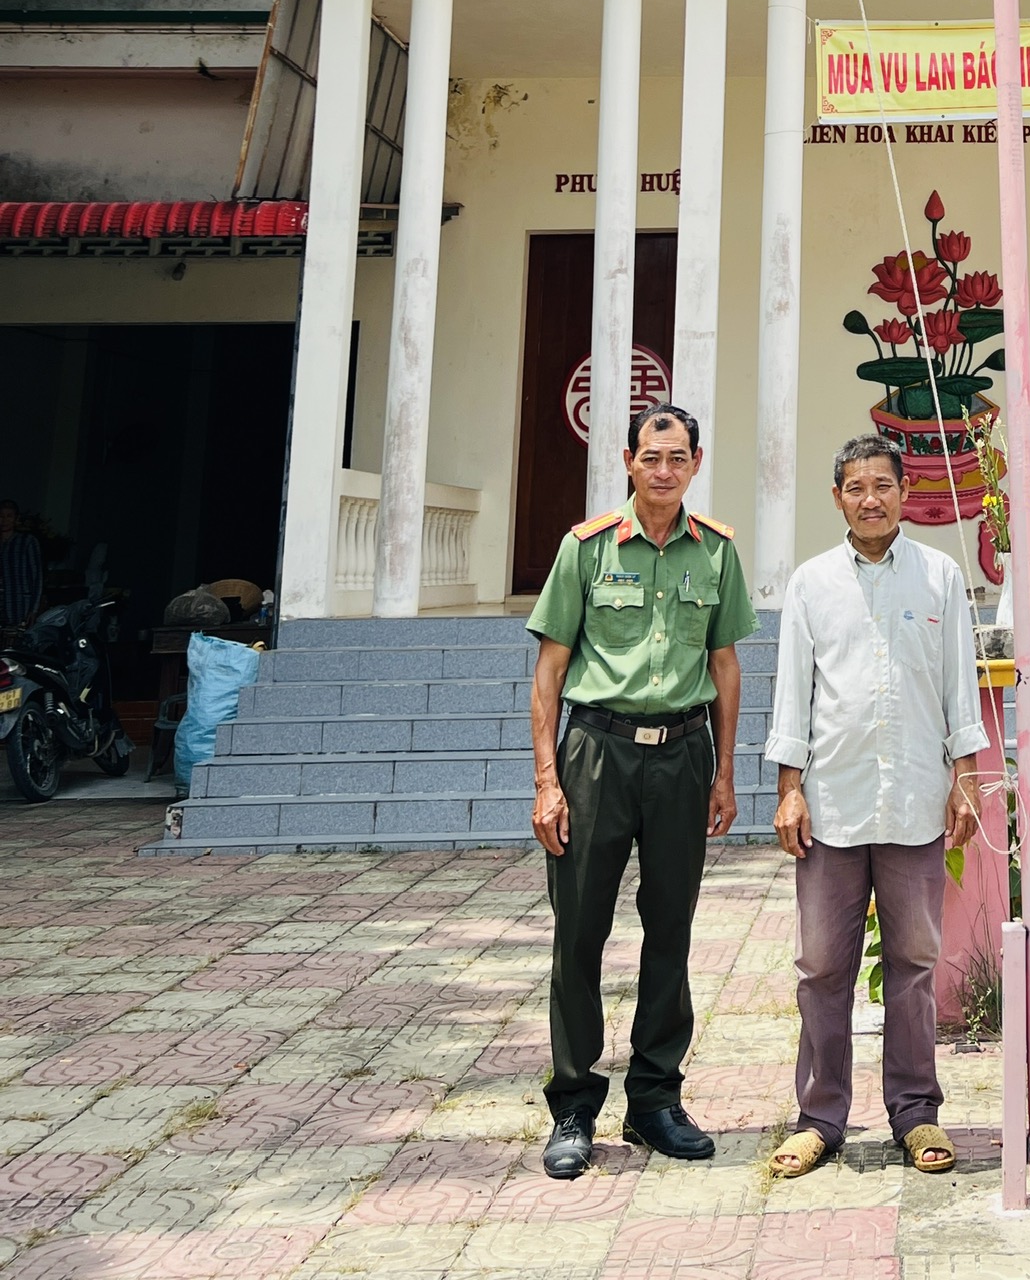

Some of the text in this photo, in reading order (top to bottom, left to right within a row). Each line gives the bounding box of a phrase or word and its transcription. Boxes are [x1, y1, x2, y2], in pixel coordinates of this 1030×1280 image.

[828, 41, 874, 95] MÙA
[879, 52, 908, 94] VU
[914, 51, 956, 92] LAN
[855, 125, 897, 144] HOA
[905, 125, 954, 144] KHAI
[962, 118, 998, 144] KIẾ
